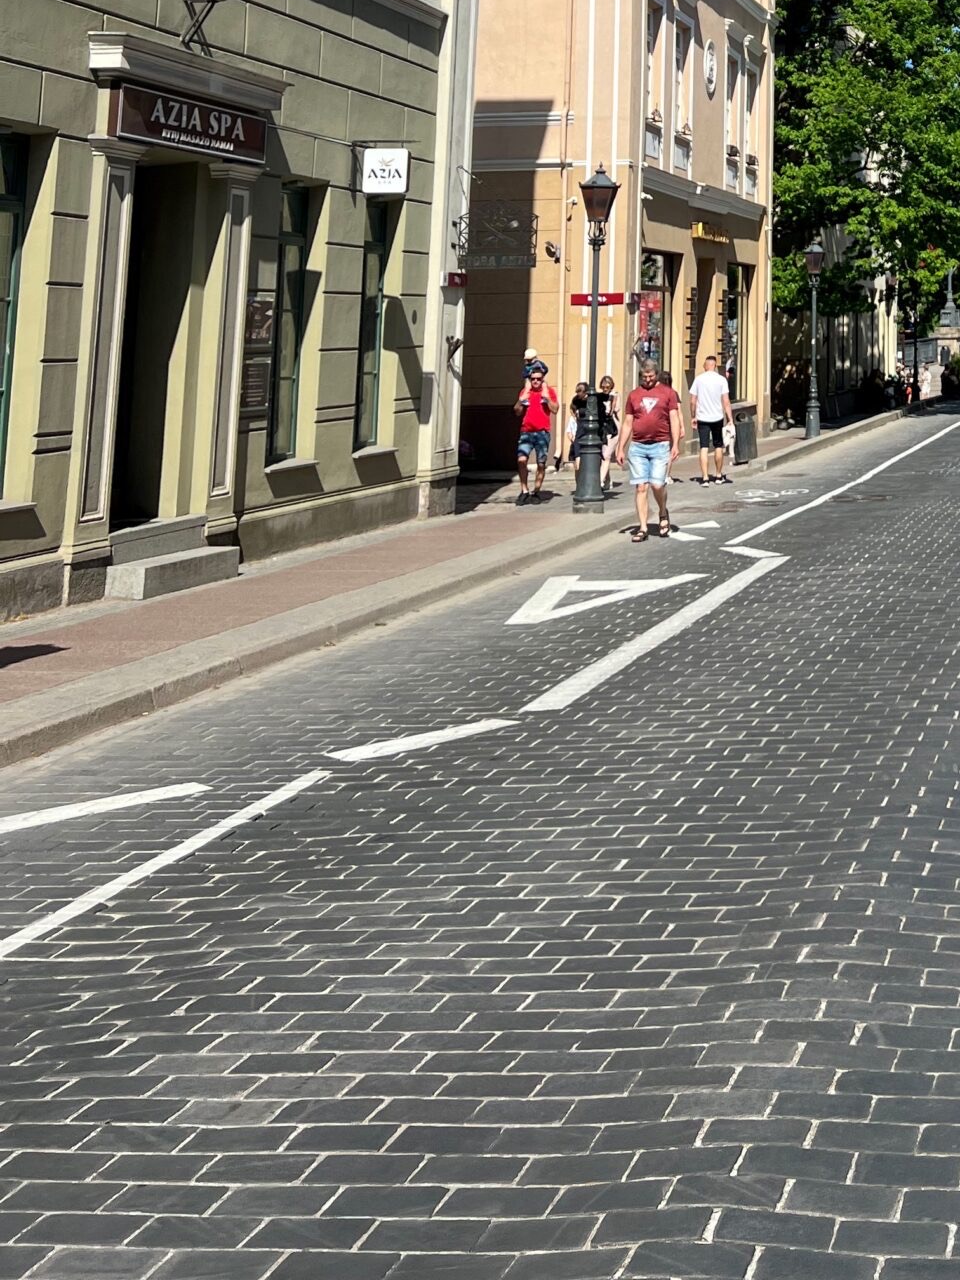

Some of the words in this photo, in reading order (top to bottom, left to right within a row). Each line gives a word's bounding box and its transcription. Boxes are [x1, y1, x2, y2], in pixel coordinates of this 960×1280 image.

[151, 98, 202, 132] AZIA
[208, 111, 245, 141] SPA
[368, 169, 402, 178] AZIA
